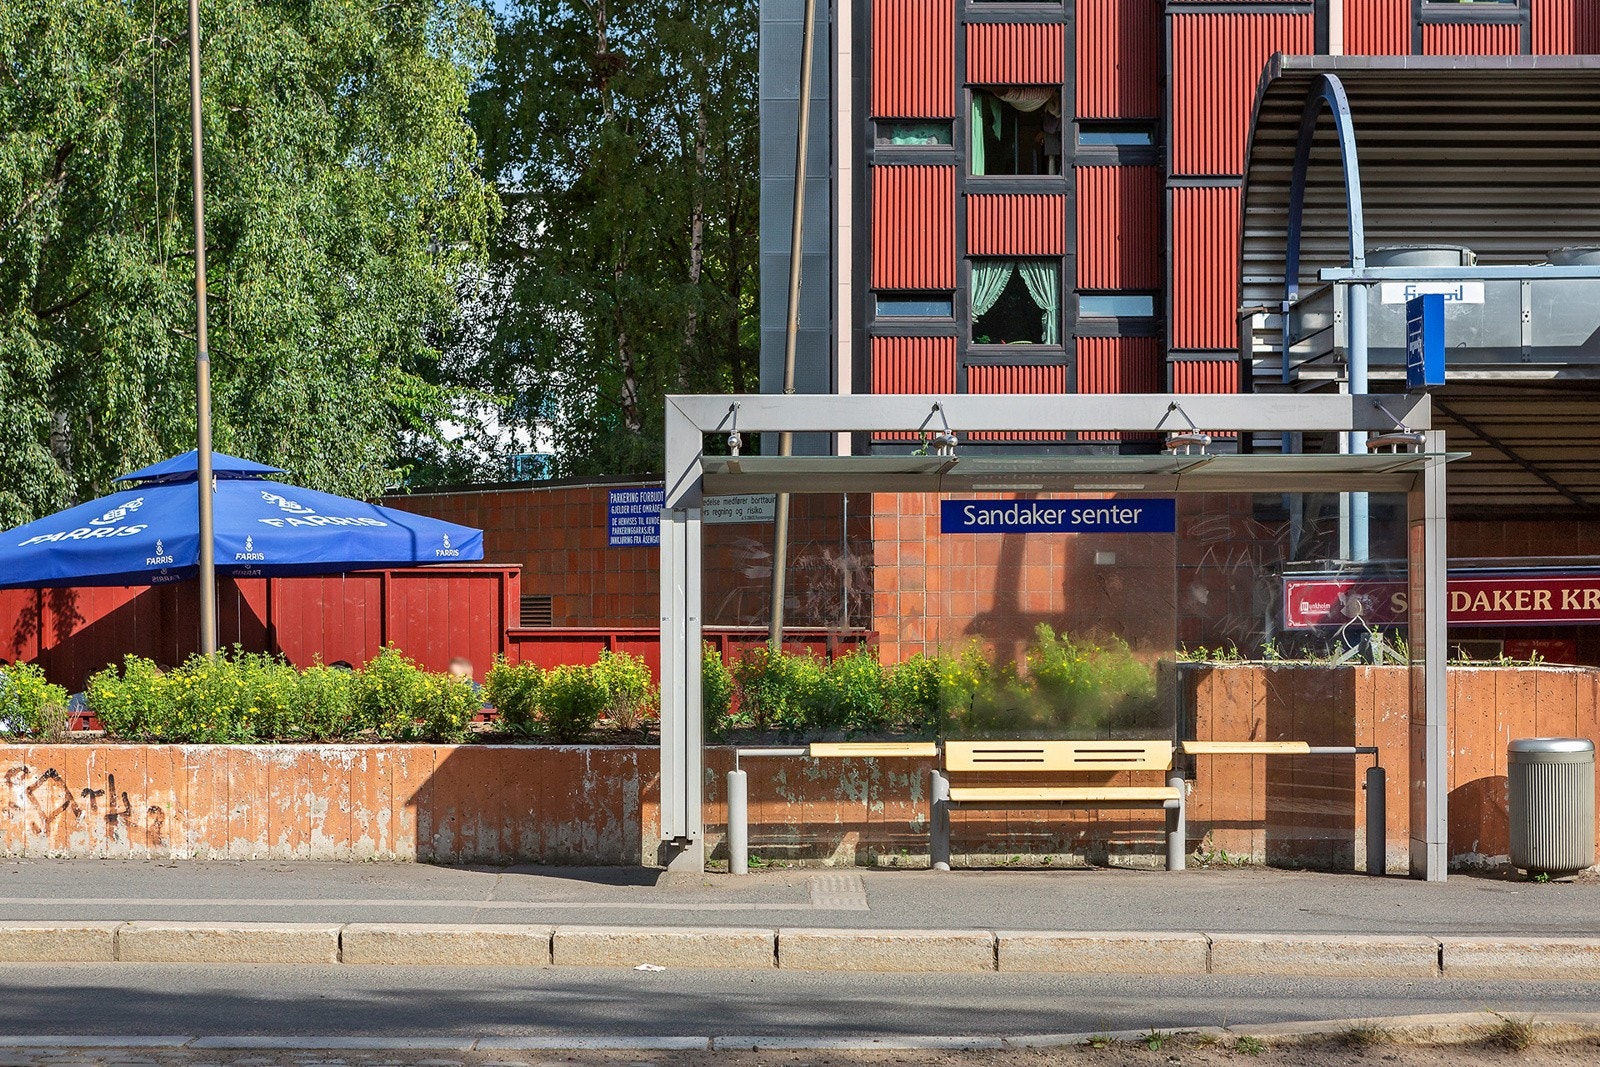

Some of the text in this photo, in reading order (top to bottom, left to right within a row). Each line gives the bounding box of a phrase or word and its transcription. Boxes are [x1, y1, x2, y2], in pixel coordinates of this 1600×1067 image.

[611, 491, 664, 503] PARKERING FORBUDT
[611, 505, 630, 514] GJELDER
[630, 504, 642, 514] HELE
[712, 508, 732, 517] regning
[736, 508, 743, 517] og
[963, 503, 1143, 526] Sandaker senter
[258, 515, 388, 528] FARRIS
[611, 518, 618, 526] DE
[18, 524, 149, 547] FARRIS
[633, 535, 642, 544] FRA
[235, 552, 265, 561] FARRIS
[435, 549, 459, 557] FARRIS
[146, 555, 174, 566] FARRIS
[1390, 589, 1553, 614] SDAKER
